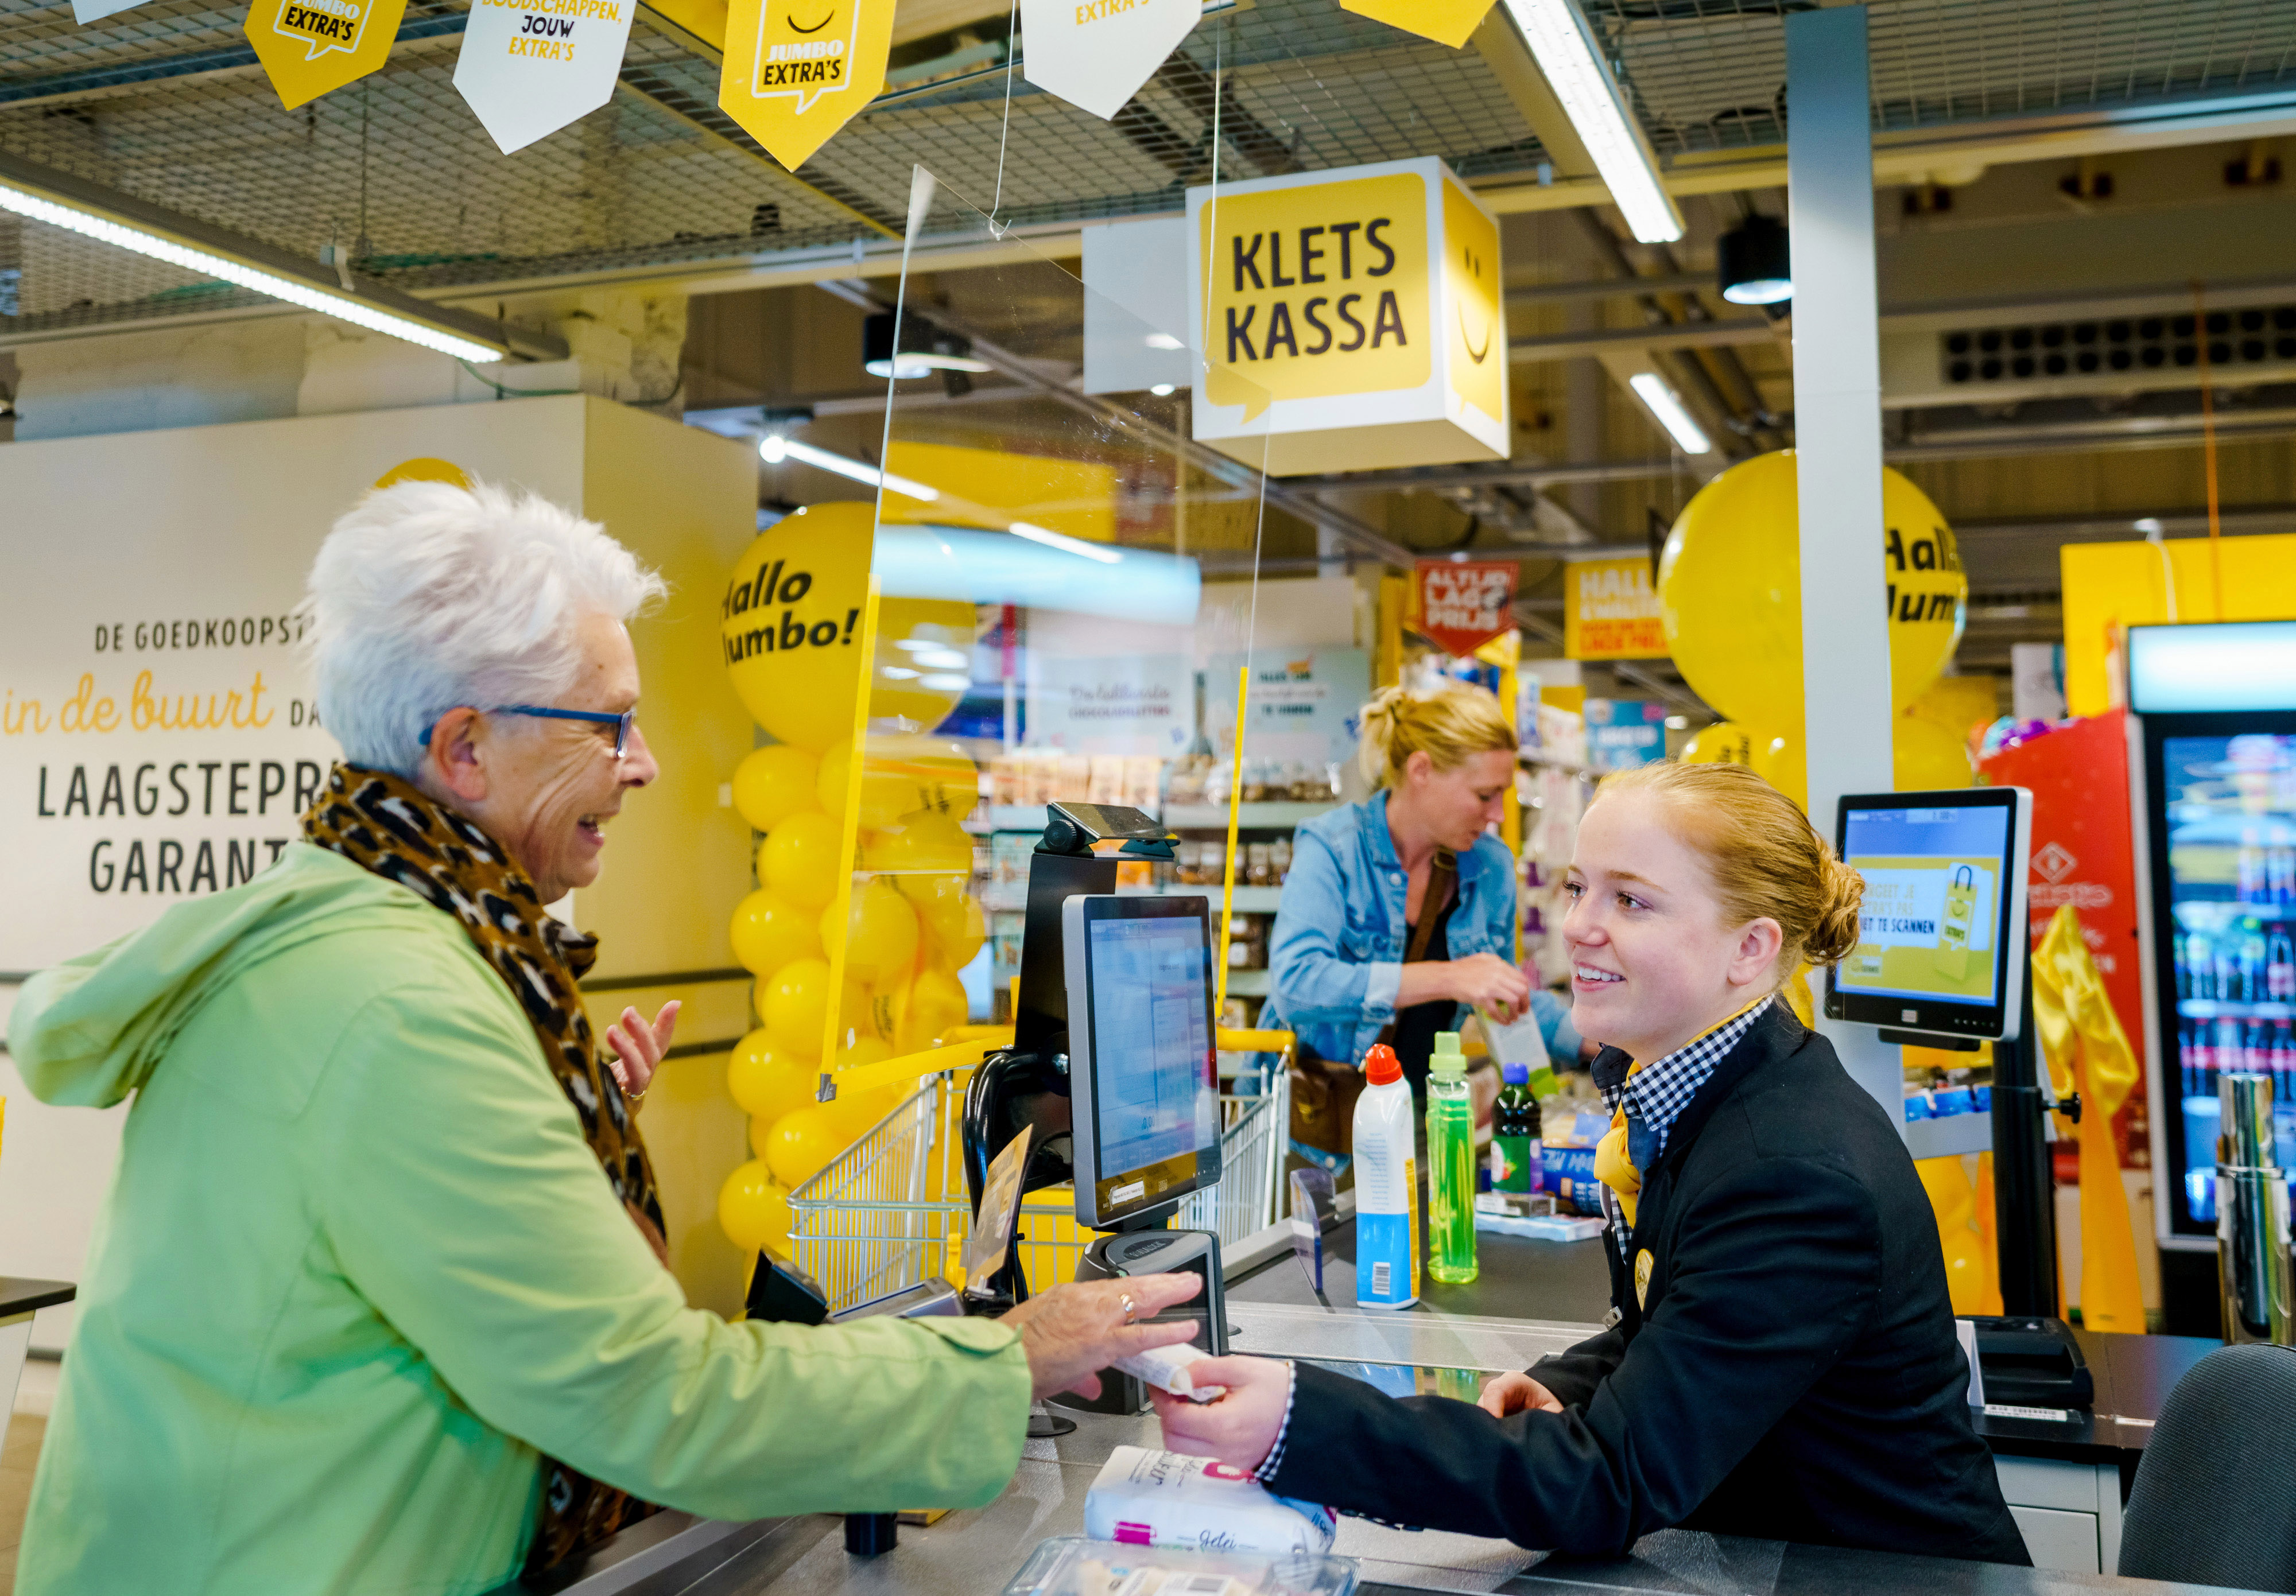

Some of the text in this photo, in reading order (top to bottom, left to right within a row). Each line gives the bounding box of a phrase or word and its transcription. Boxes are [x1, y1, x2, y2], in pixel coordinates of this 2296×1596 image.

[284, 6, 355, 41] EXTRA'S
[521, 15, 575, 38] JOUW
[508, 36, 575, 61] EXTRA'S
[765, 39, 844, 63] JUMBO
[763, 59, 841, 86] EXTRA'S
[1231, 218, 1397, 292] KLETS
[1225, 290, 1408, 364] KASSA
[95, 614, 317, 652] DE GOEDKOOPST
[2, 669, 323, 735] in de buurt DA
[37, 759, 339, 818] LAAGSTEPR
[89, 838, 289, 894] GARANT
[1878, 918, 1887, 932] TE
[1891, 918, 1934, 934] SCANNEN
